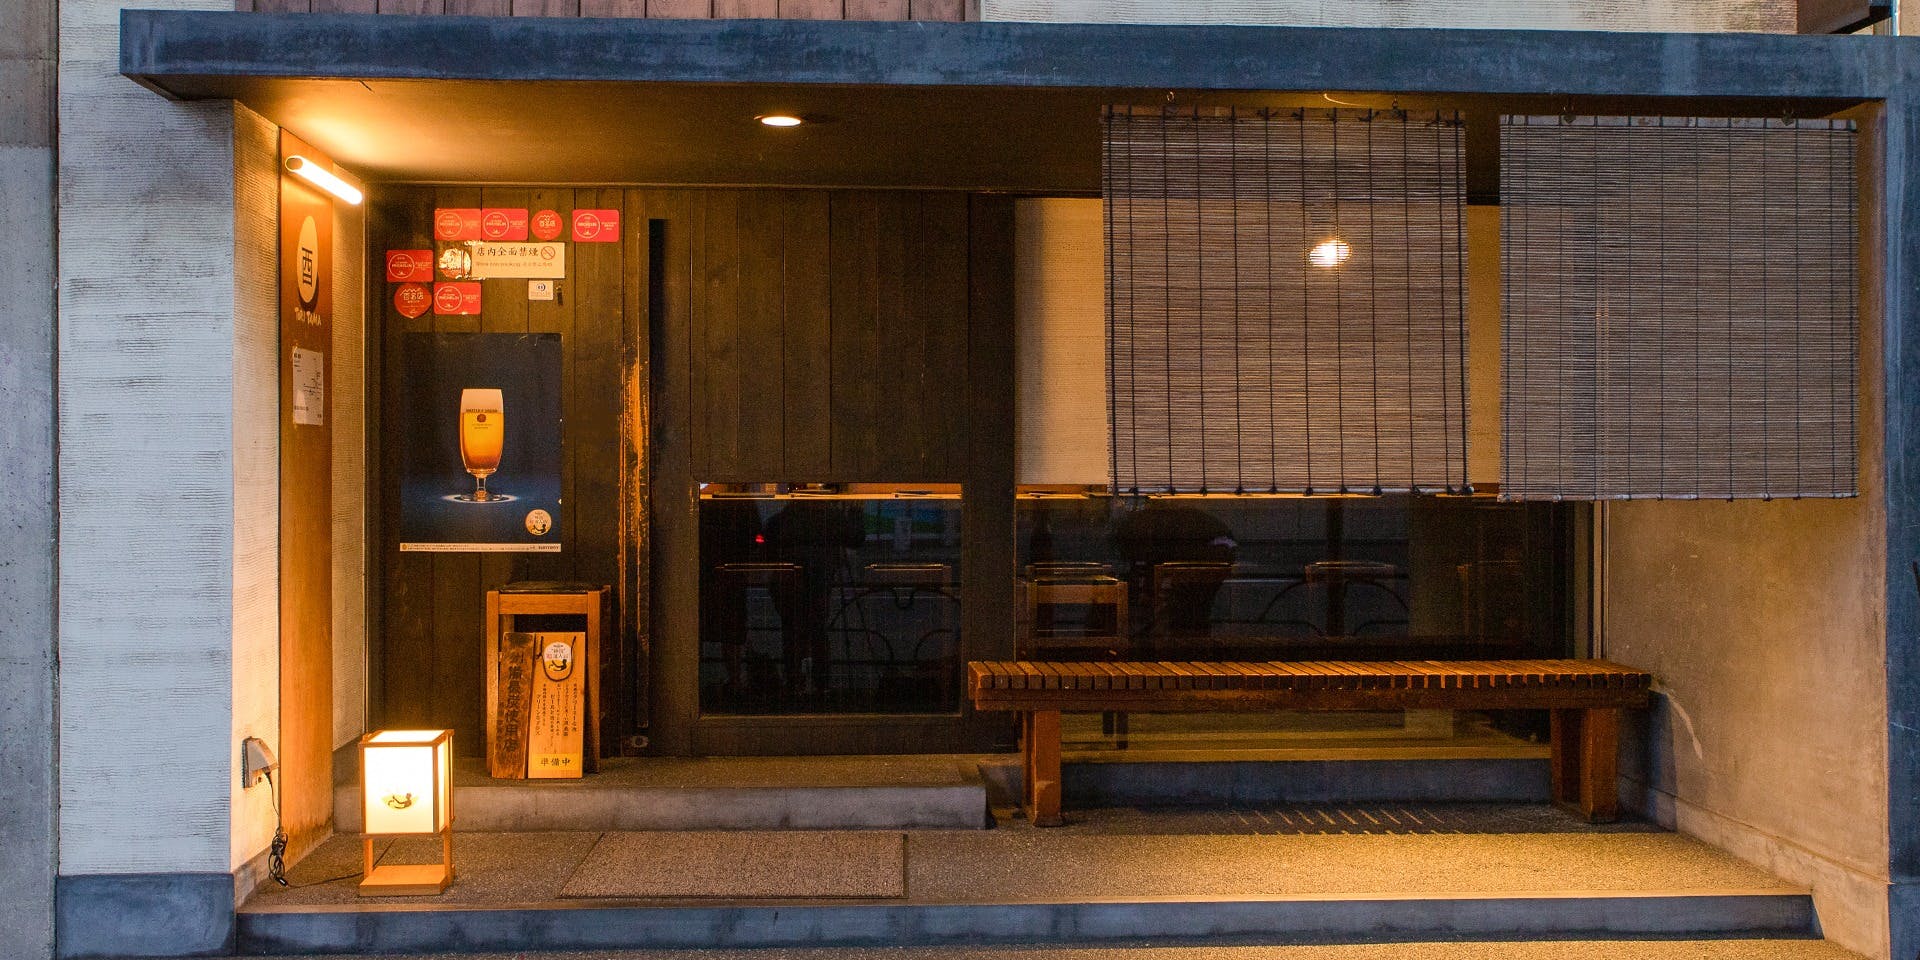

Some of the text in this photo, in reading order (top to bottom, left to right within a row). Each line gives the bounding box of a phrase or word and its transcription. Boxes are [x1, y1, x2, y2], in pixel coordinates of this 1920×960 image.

[477, 246, 539, 256] 店内全面禁煙
